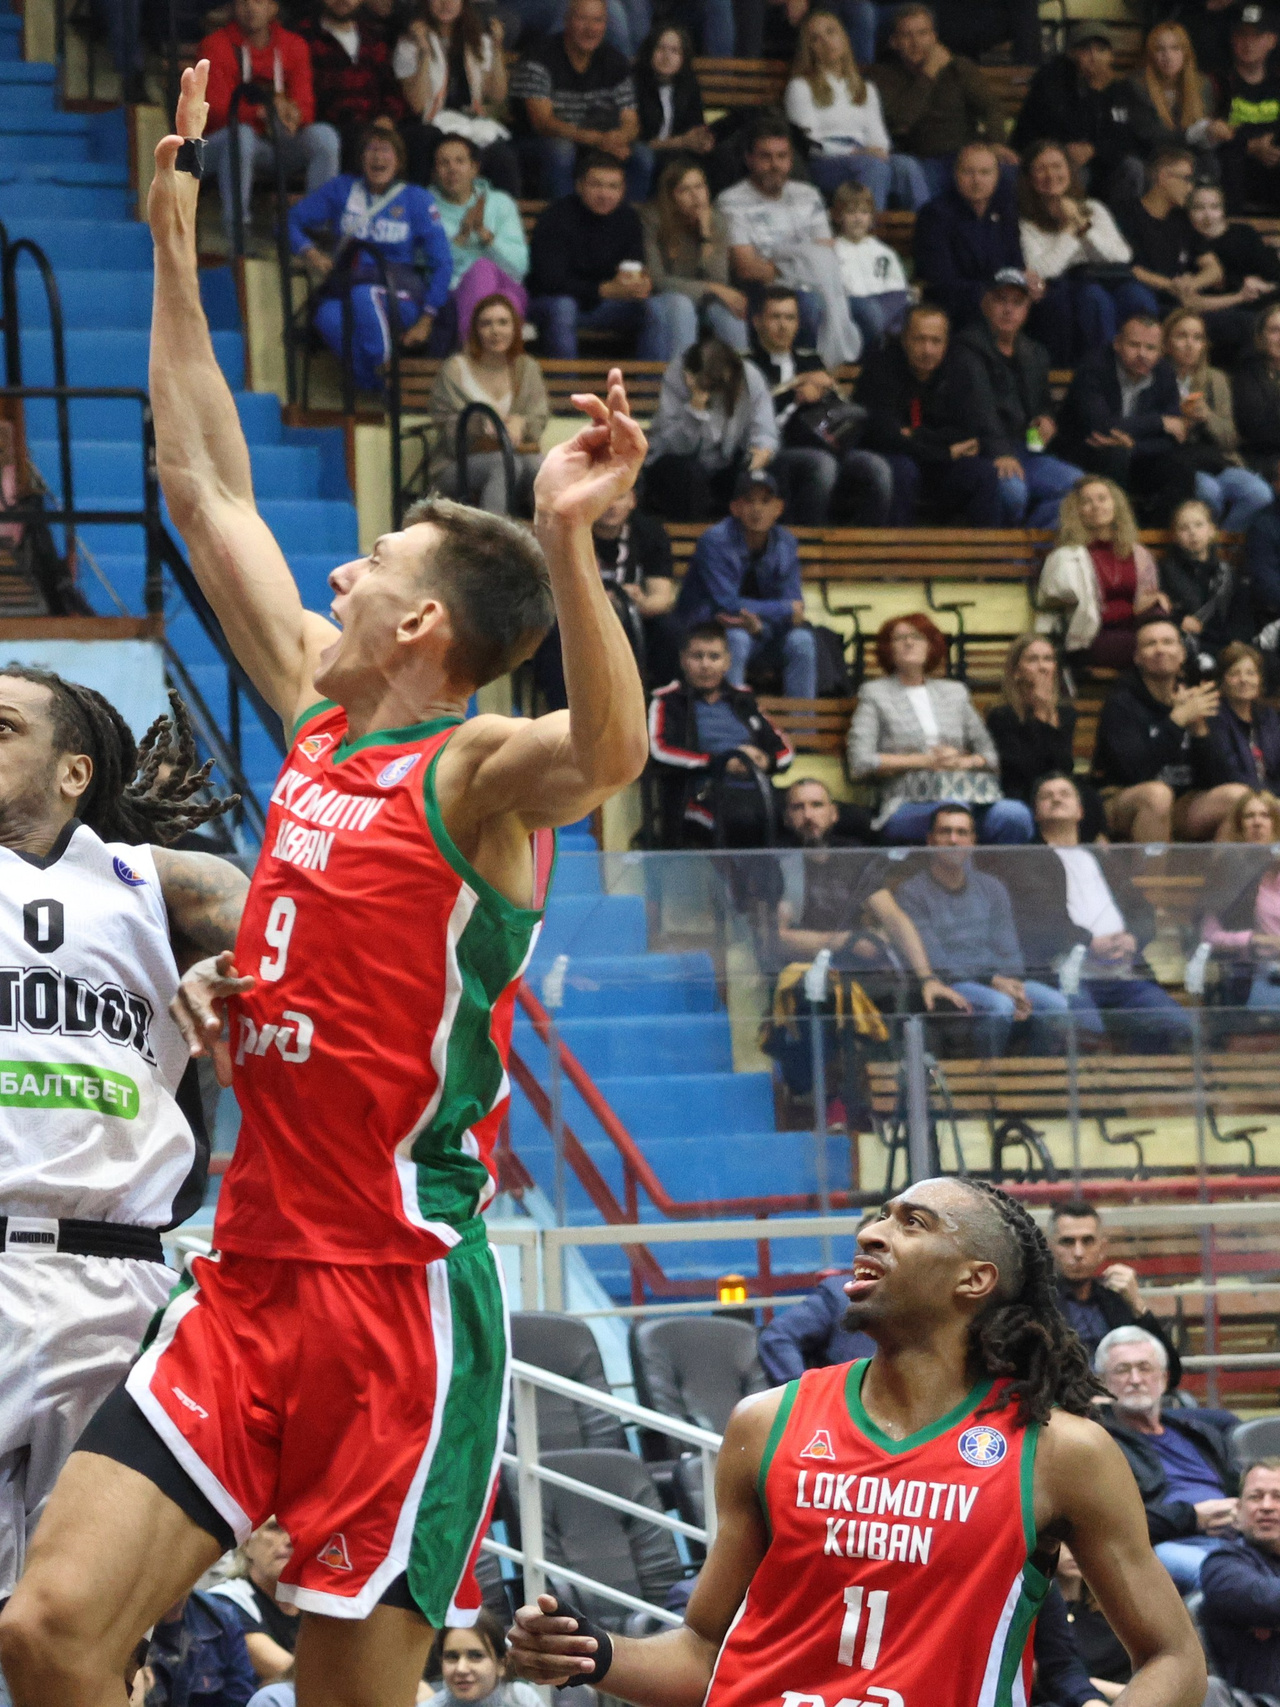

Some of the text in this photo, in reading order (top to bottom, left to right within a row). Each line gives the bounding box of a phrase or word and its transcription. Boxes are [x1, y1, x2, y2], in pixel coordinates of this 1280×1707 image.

[23, 898, 64, 954] 0
[259, 896, 297, 982] 9
[0, 1071, 133, 1108] БАЛТБЕТ
[796, 1470, 979, 1522] LOKOMOTIV
[823, 1517, 933, 1565] KUBAN
[837, 1585, 889, 1671] 11
